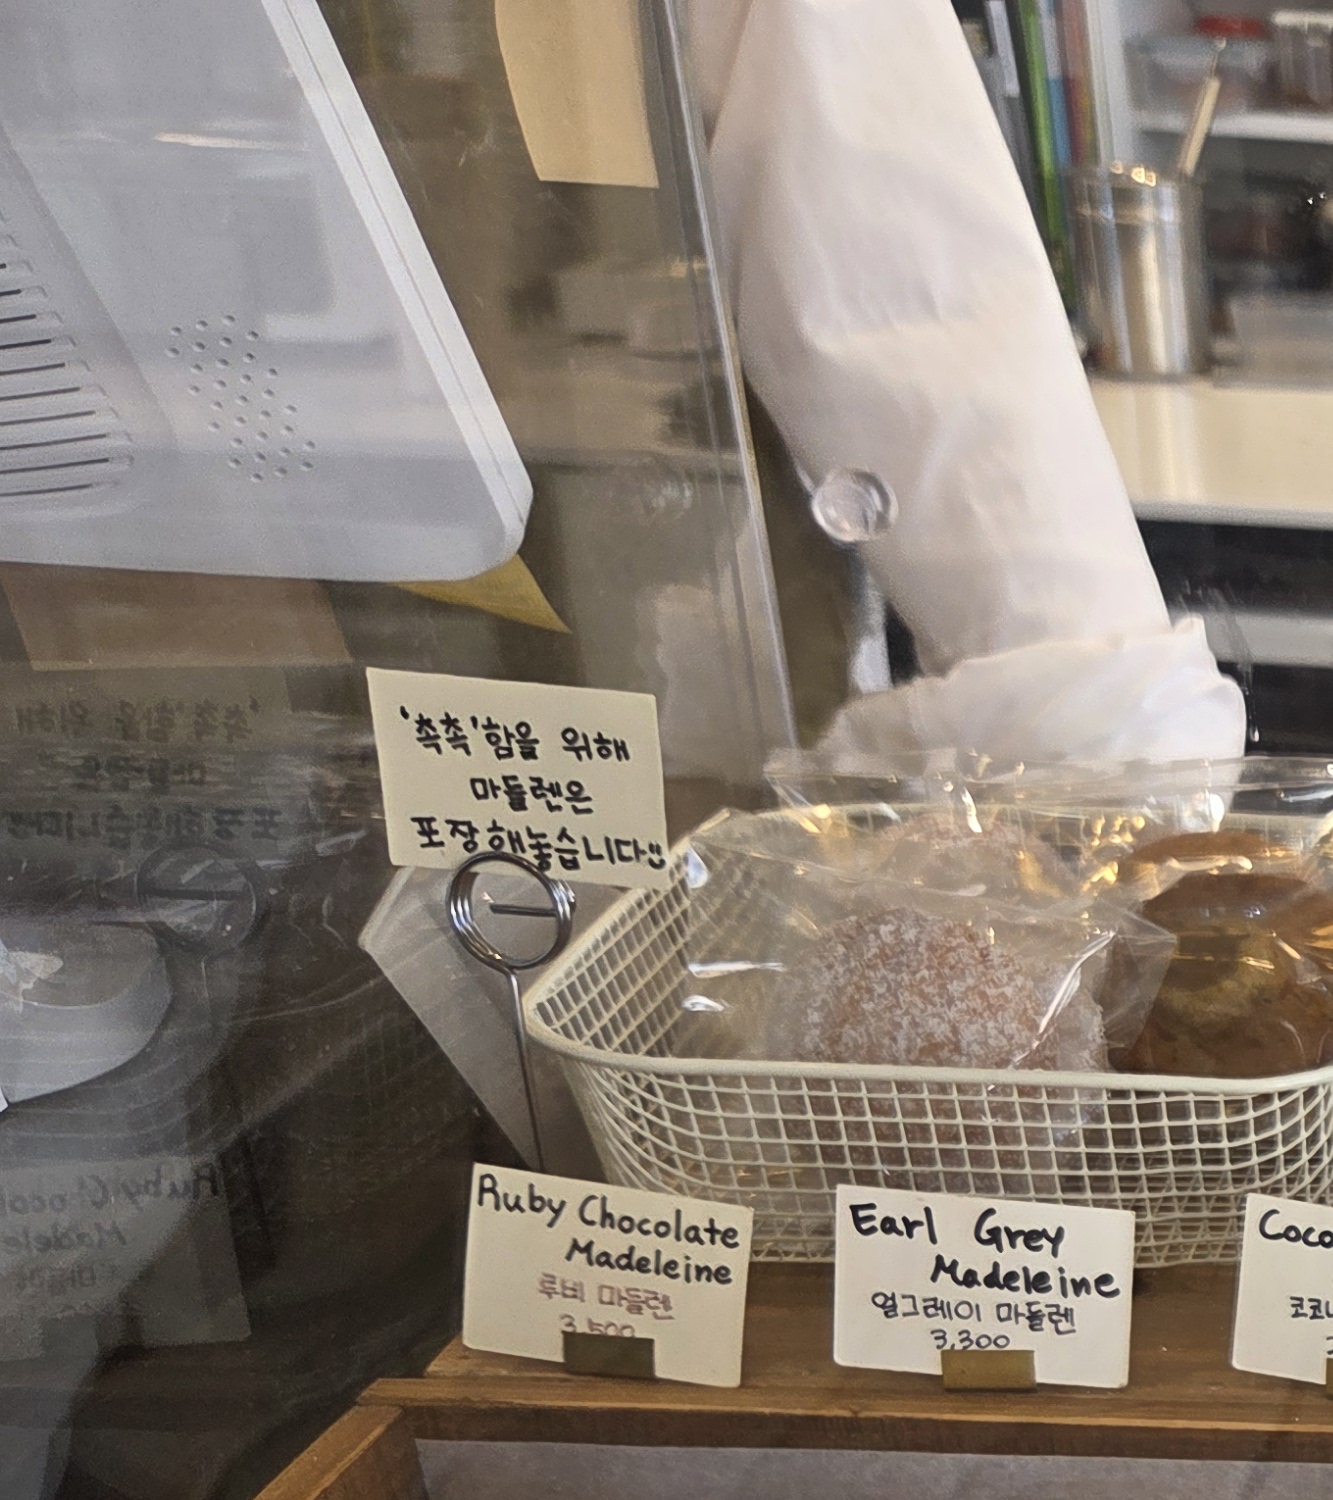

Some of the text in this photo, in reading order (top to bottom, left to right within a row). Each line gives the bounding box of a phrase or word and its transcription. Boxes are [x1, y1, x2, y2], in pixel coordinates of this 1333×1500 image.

[561, 726, 631, 762] 위해
[469, 775, 594, 816] 마들렌은
[477, 1173, 740, 1249] Ruby Chocolate
[849, 1202, 1065, 1258] Earl Grey
[564, 1237, 733, 1285] Madeleine
[930, 1254, 1121, 1299] Madeleine
[537, 1272, 675, 1320] 루비 마들렌
[995, 1300, 1077, 1335] 마들렌
[930, 1328, 1011, 1350] 3,300
